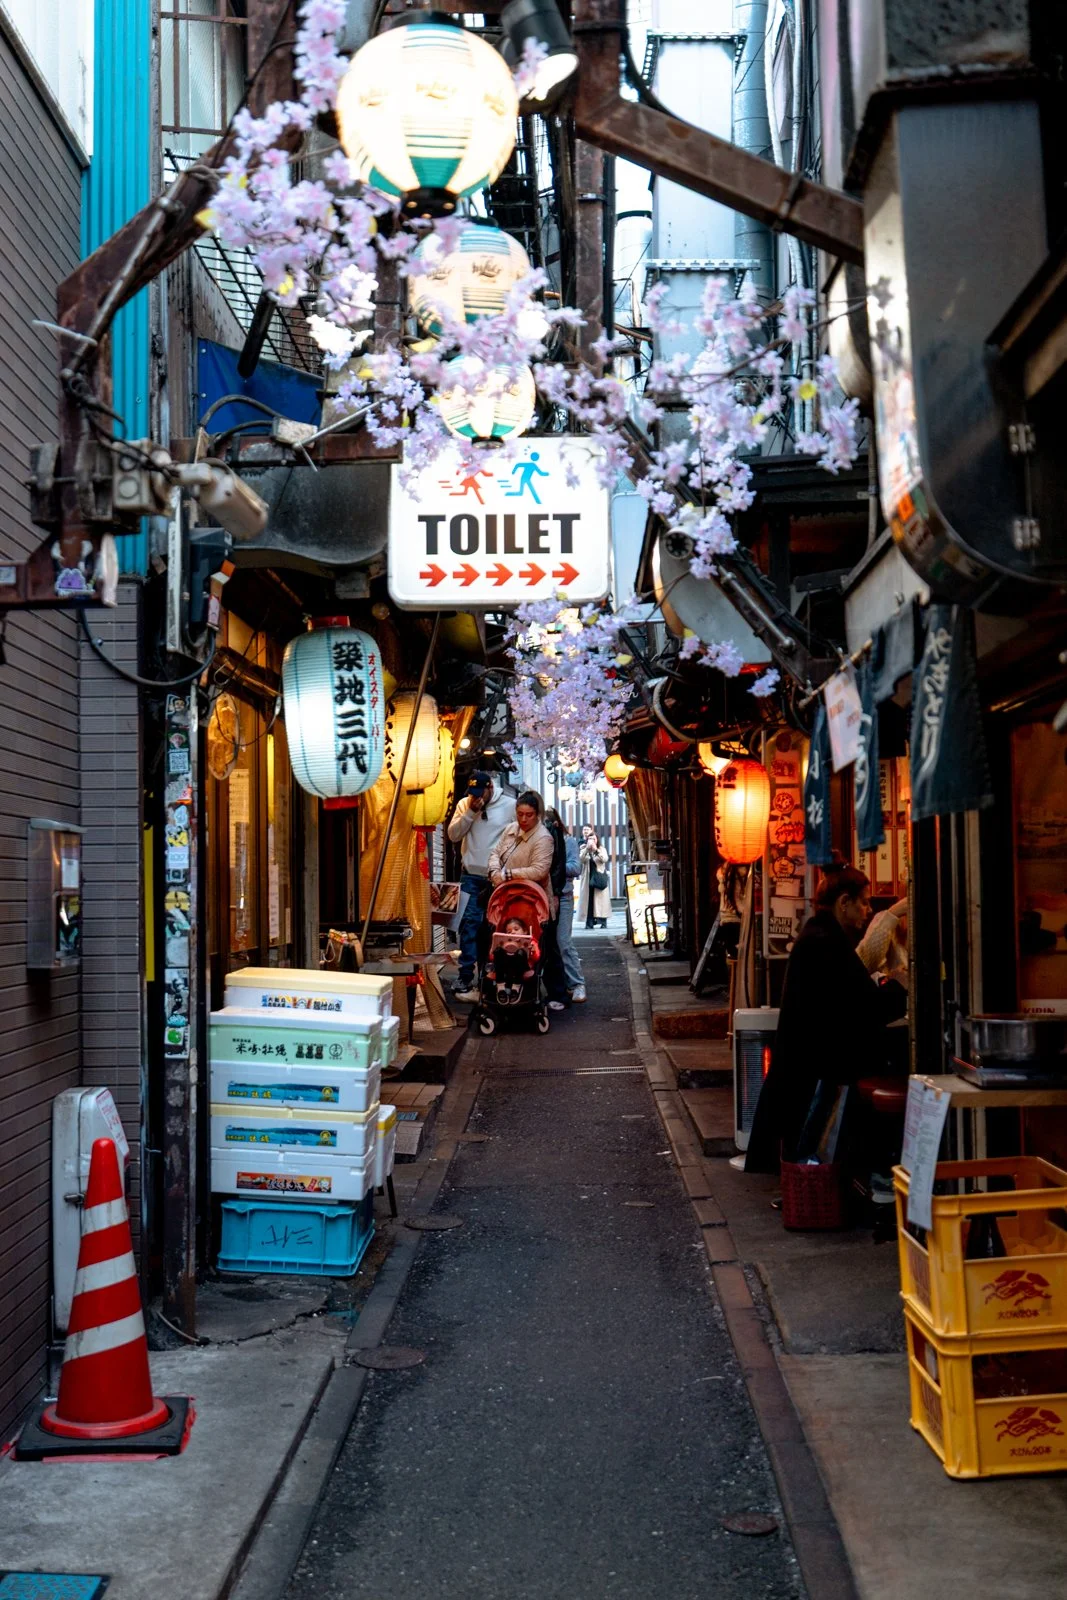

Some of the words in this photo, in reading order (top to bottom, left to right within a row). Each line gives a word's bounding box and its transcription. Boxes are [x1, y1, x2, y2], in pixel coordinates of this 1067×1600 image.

[417, 513, 581, 556] TOILET
[332, 640, 369, 775] 築地三代
[367, 651, 380, 751] オイスターバー
